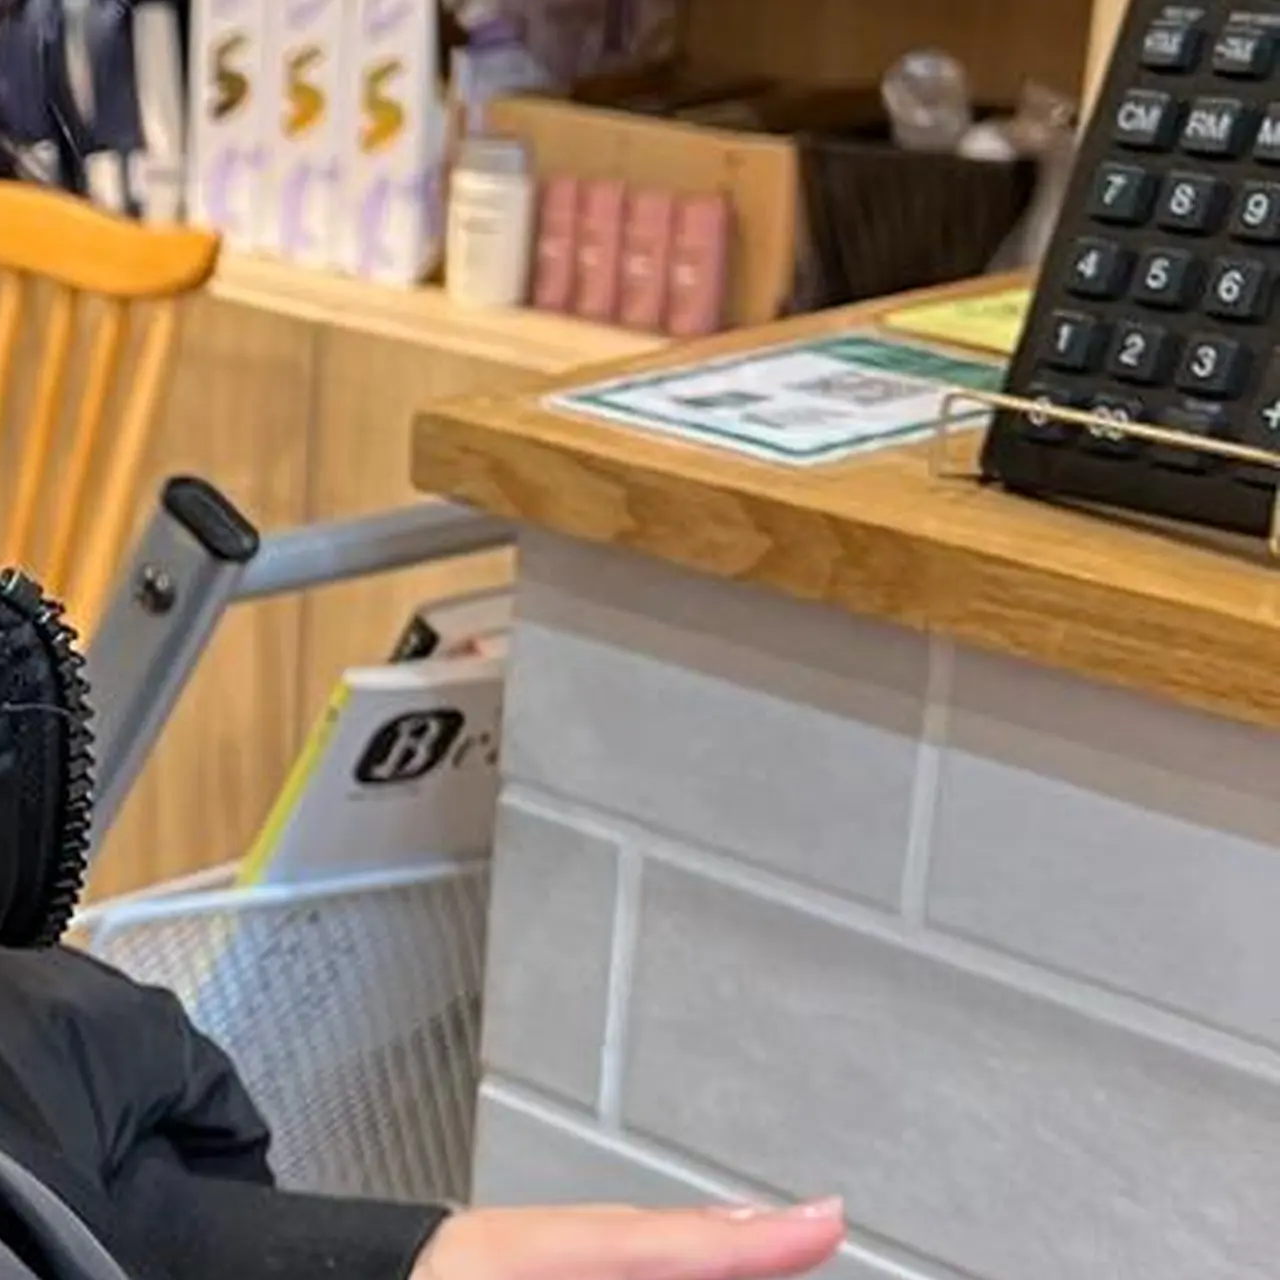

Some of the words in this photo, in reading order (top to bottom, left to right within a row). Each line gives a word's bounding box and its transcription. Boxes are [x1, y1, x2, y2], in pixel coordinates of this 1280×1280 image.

[1103, 174, 1128, 205] 7
[1170, 183, 1195, 215] 8
[1243, 192, 1269, 225] 9
[1076, 250, 1099, 279] 4
[1217, 270, 1244, 302] 6
[1056, 323, 1072, 353] 1
[1119, 333, 1146, 367] 2
[1192, 345, 1218, 378] 3
